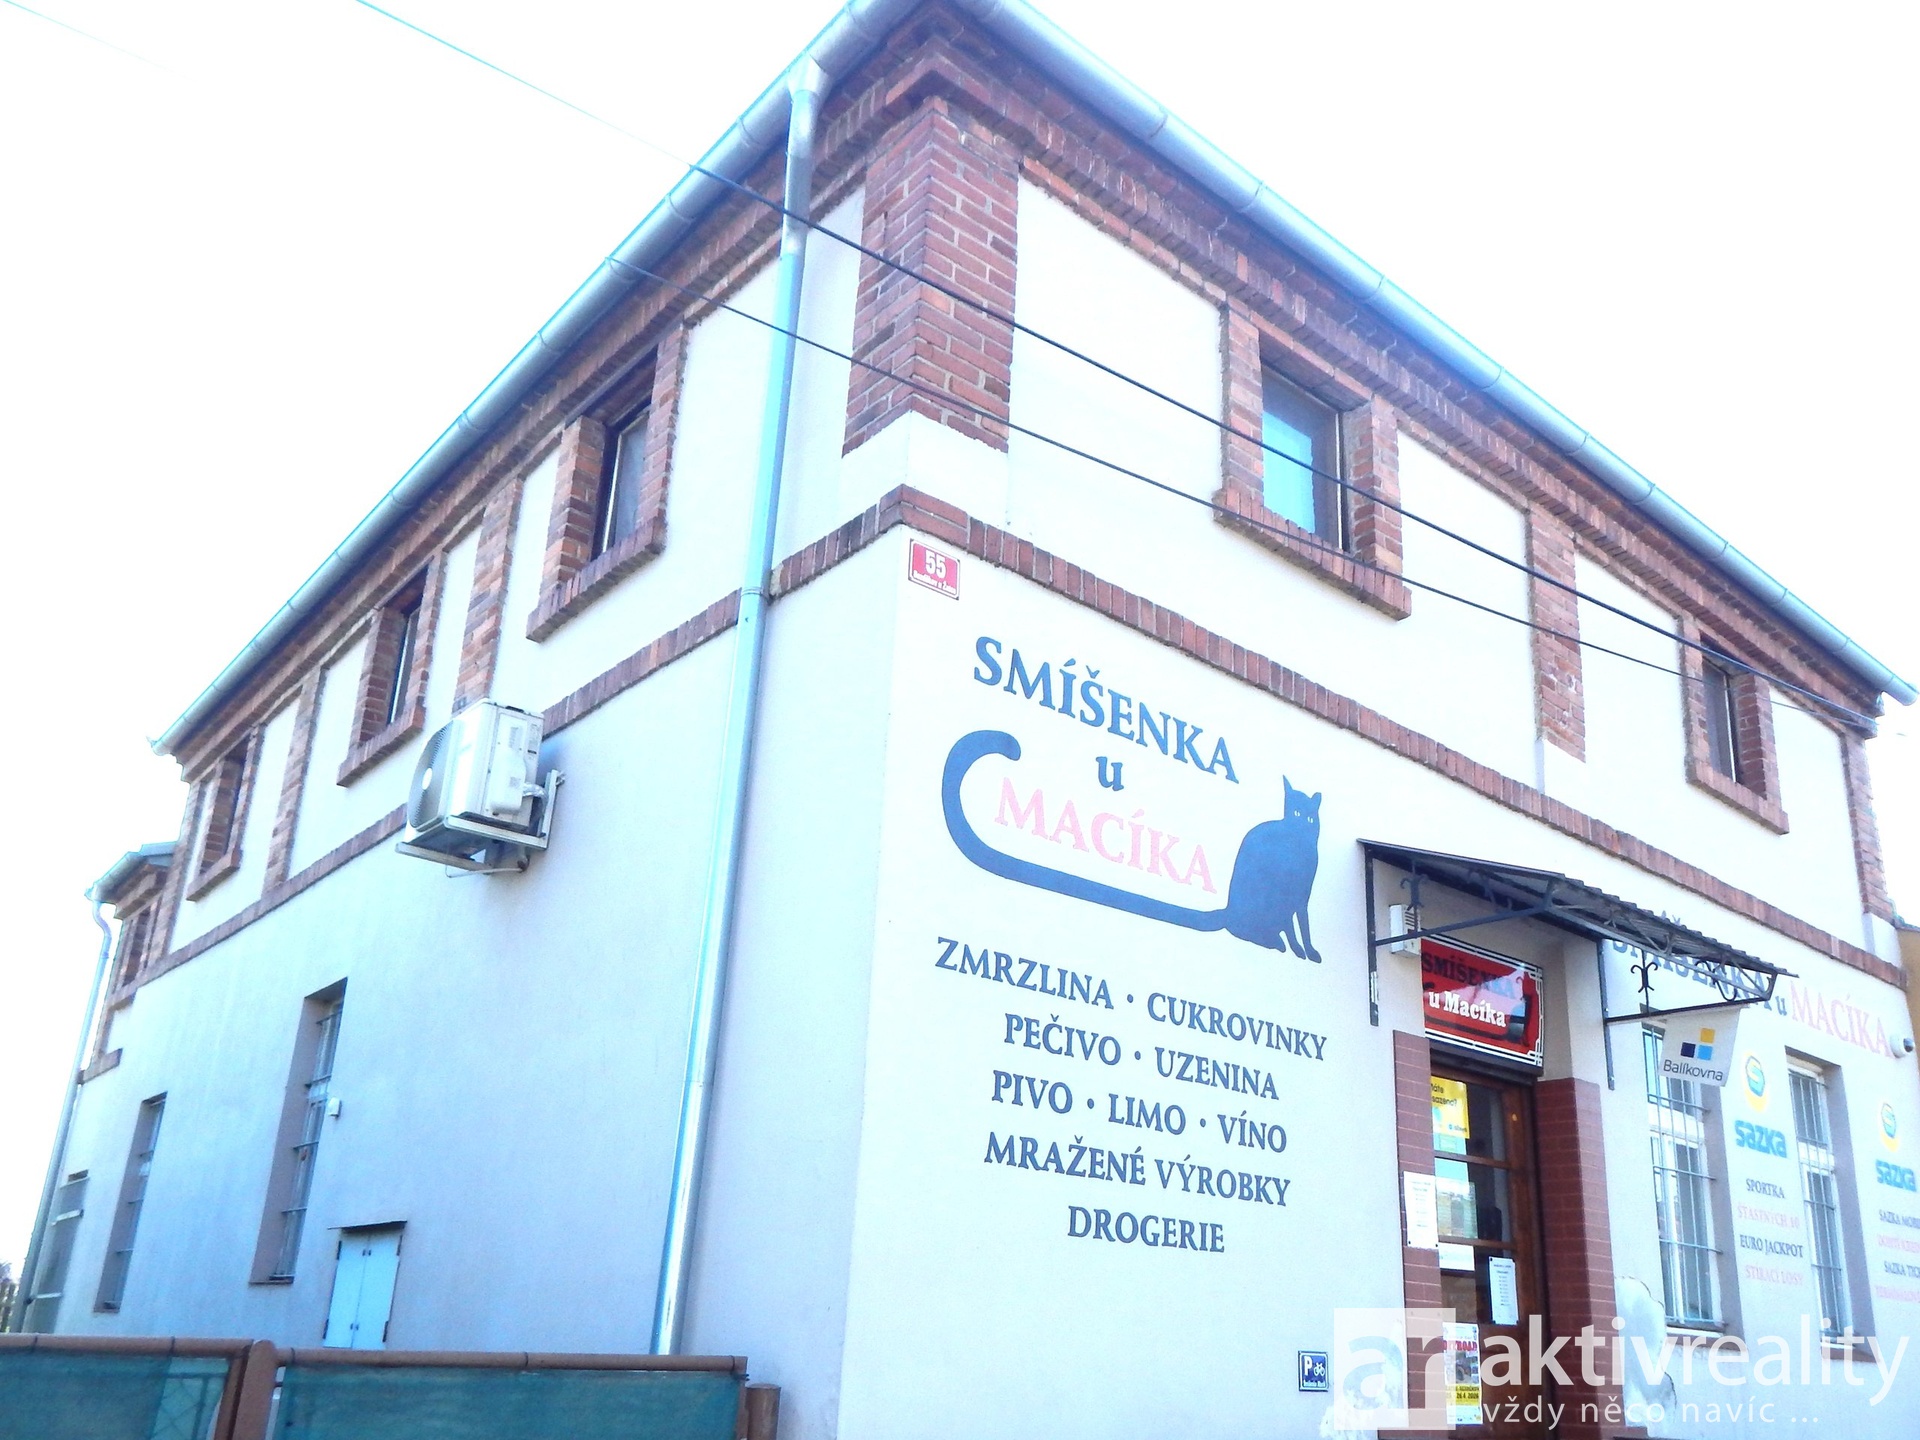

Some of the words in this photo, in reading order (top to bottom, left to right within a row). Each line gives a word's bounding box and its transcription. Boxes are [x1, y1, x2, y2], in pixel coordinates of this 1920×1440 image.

[925, 549, 947, 579] 55
[973, 636, 1239, 784] SMÍŠENKA
[1095, 756, 1124, 791] u
[994, 777, 1217, 894] MACÍKA
[935, 936, 1114, 1010] ZMRZLINA
[1147, 992, 1328, 1061] CUKROVINKY
[1429, 991, 1440, 1009] u
[1443, 990, 1507, 1027] Macíka
[1776, 995, 1788, 1016] u
[1789, 980, 1893, 1059] MACÍKA
[1004, 1013, 1122, 1065] PEČIVO
[1155, 1047, 1280, 1100] UZENINA
[1663, 1059, 1724, 1081] Balíkovna
[991, 1070, 1073, 1114] PIVO
[1108, 1093, 1187, 1135] LIMO
[1217, 1110, 1287, 1153] VÍNO
[984, 1132, 1146, 1186] MRAŽENÉ
[1154, 1155, 1291, 1206] VÝROBKY
[1745, 1178, 1785, 1199] SPORTKA
[1067, 1205, 1226, 1253] DROGERIE
[1740, 1234, 1763, 1252] EURO
[1764, 1238, 1804, 1258] JACKPOT
[1304, 1355, 1313, 1376] P
